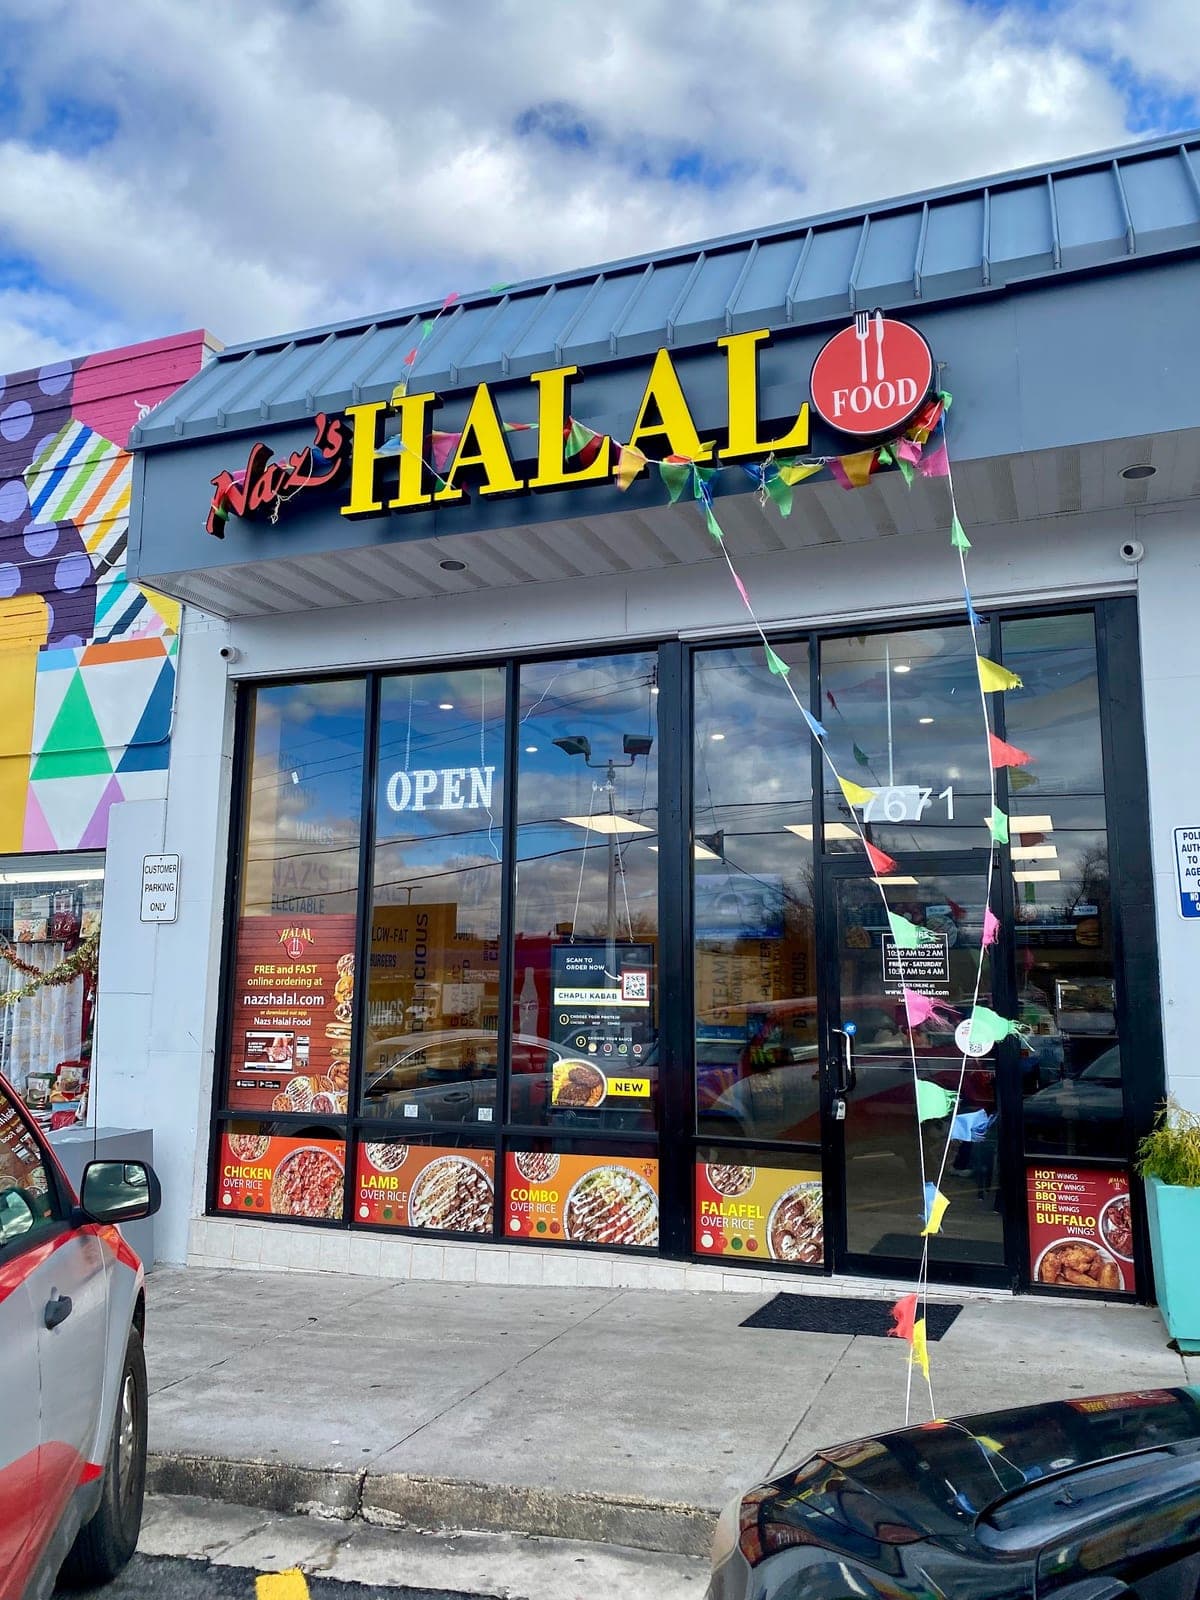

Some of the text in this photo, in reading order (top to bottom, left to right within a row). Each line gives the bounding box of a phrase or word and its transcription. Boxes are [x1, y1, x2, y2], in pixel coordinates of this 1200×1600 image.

[832, 378, 918, 417] FOOD
[341, 329, 809, 515] HALAL
[206, 411, 342, 534] Naz's
[387, 766, 494, 811] OPEN
[862, 785, 954, 822] 7671
[1187, 856, 1198, 864] TO
[144, 865, 177, 874] CUSTOMER
[144, 883, 175, 892] PARKING
[150, 902, 167, 911] ONLY
[371, 927, 408, 943] LOW-FAT
[254, 965, 317, 974] FREE and FAST
[247, 977, 273, 986] online
[275, 977, 312, 988] ordering
[243, 992, 324, 1005] nazshalal.com
[254, 1017, 311, 1026] Nazs Halal Food
[615, 1082, 643, 1093] NEW
[224, 1165, 272, 1180] CHICKEN
[1034, 1170, 1056, 1180] HOT
[223, 1178, 263, 1190] OVER RICE
[361, 1174, 399, 1190] LAMB
[1035, 1181, 1086, 1192] SPICY WINGS
[360, 1188, 408, 1202] OVER RICE
[510, 1189, 559, 1203] COMBO
[1035, 1192, 1080, 1202] BBQ WINGS
[510, 1201, 556, 1214] OVER RICE
[701, 1200, 765, 1219] FALAFEL
[1036, 1203, 1080, 1213] FIRE WINGS
[701, 1215, 755, 1230] OVER RICE
[1036, 1212, 1096, 1228] BUFFALO
[1066, 1226, 1096, 1236] WINGS
